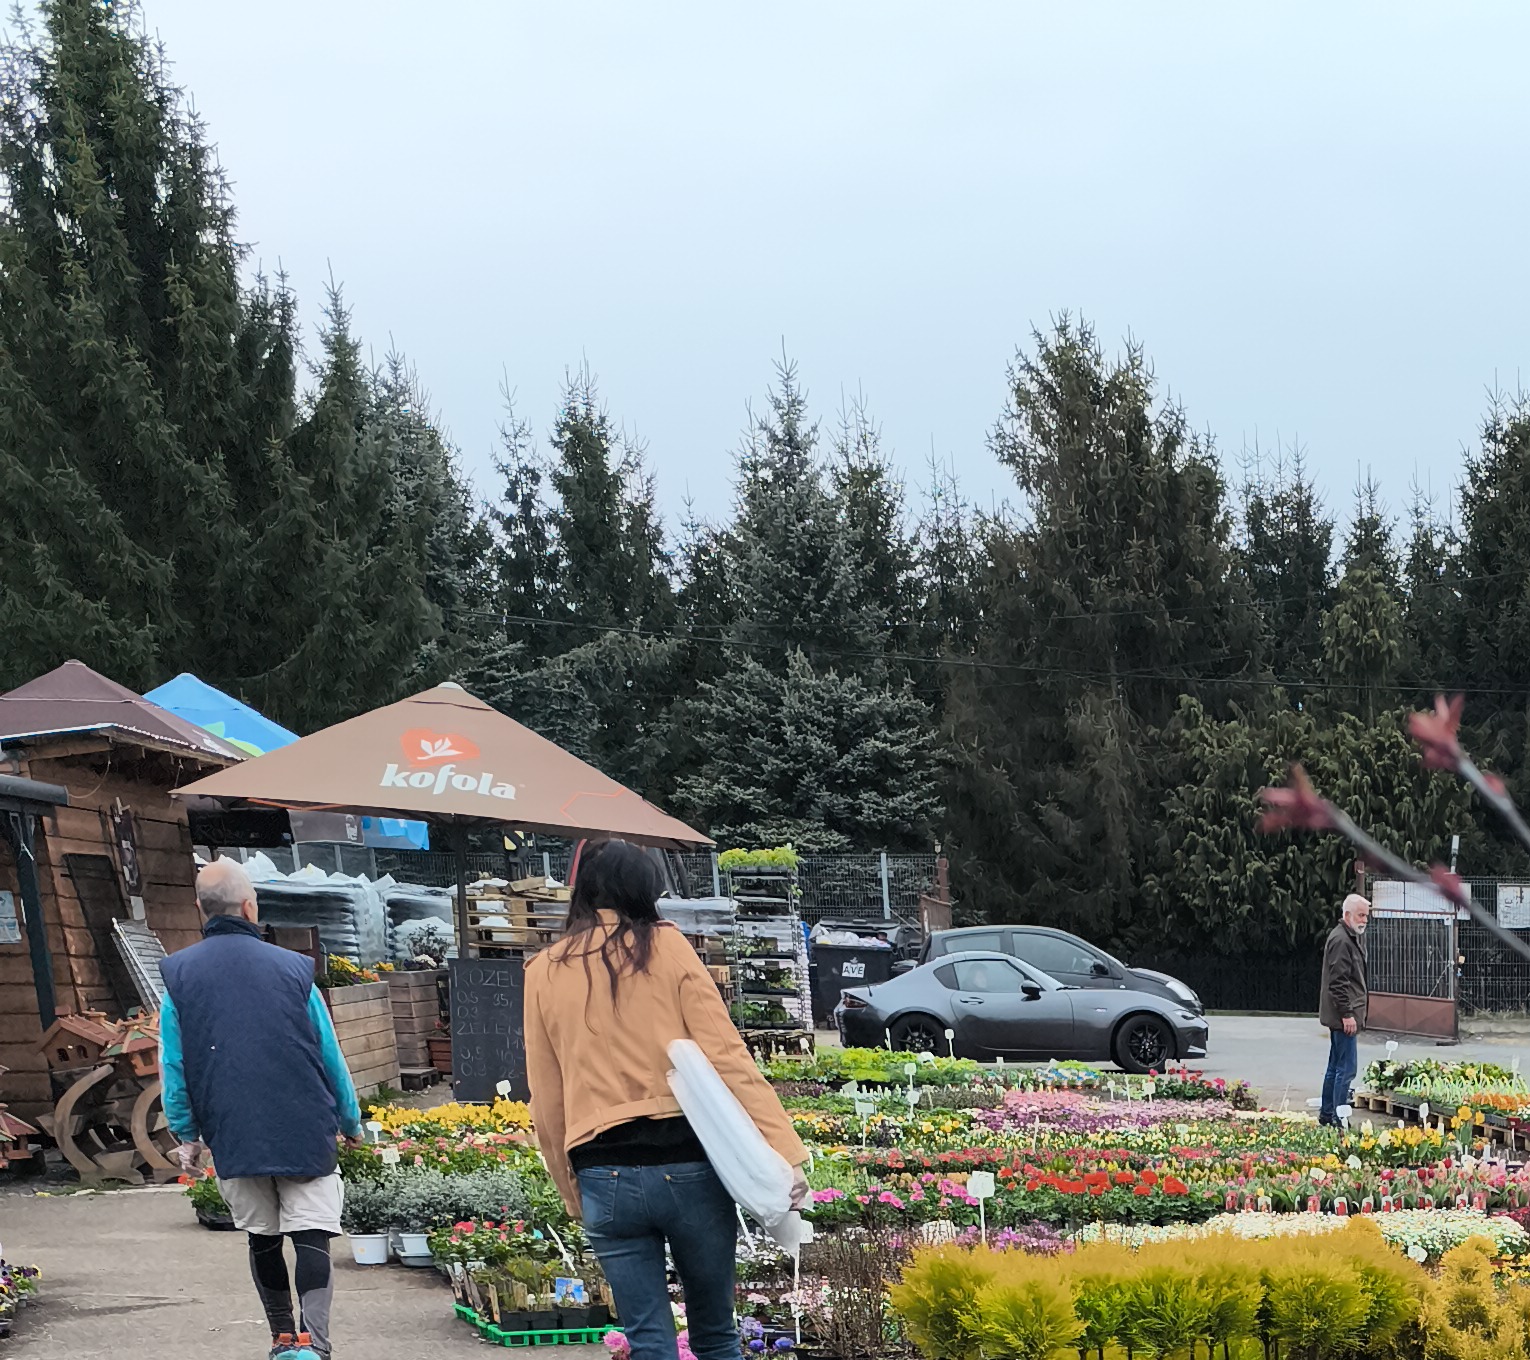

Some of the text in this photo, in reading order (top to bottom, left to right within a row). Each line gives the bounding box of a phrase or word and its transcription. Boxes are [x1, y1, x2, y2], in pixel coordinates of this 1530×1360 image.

[379, 763, 516, 800] kofola
[453, 966, 520, 988] KOZEL
[843, 965, 864, 975] AVE
